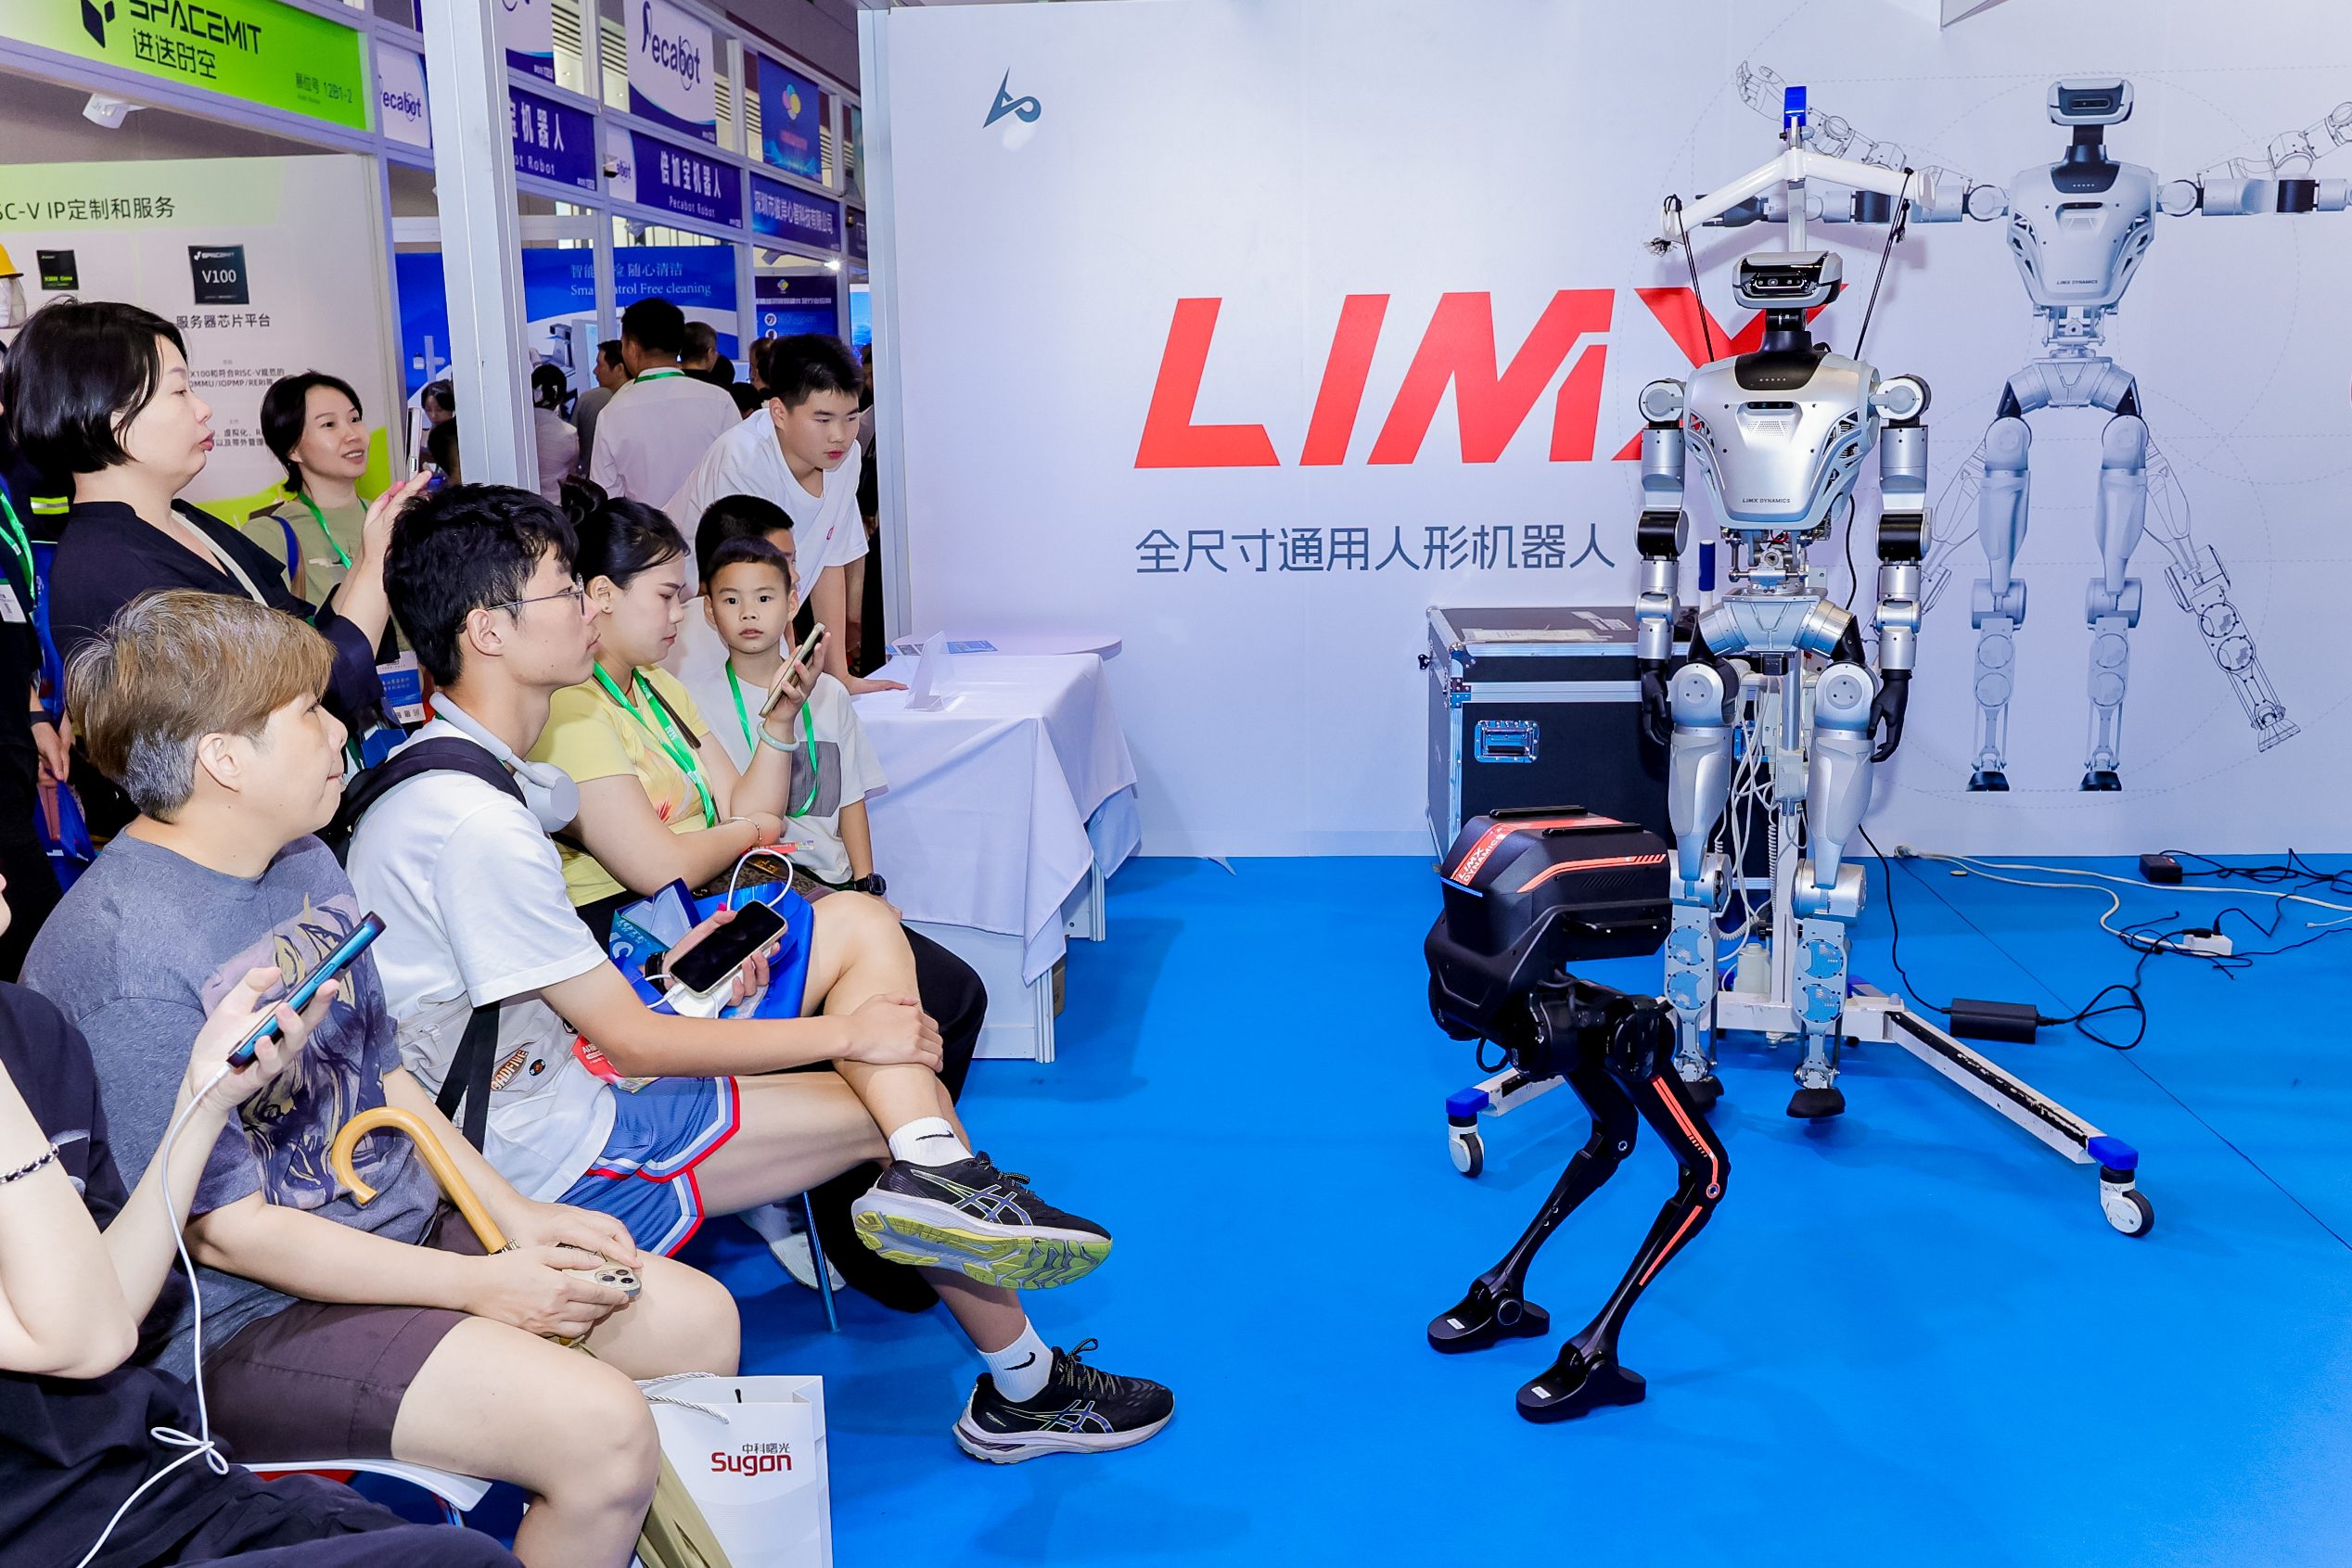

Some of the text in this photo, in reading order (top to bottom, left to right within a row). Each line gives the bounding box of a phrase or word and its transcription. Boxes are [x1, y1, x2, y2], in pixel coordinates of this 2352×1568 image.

[129, 0, 262, 55] SPACEMIT
[378, 74, 422, 121] ecabot
[510, 102, 564, 152] 机器人
[527, 155, 556, 175] Robot
[47, 196, 176, 221] IP定制和服务
[669, 195, 716, 218] Pecabot Robot
[201, 269, 237, 284] V100
[571, 281, 711, 297] Sma trol Free cleaning
[176, 312, 272, 329] 服务器芯片平台
[1134, 522, 1617, 574] 全尺寸通用人形机器人
[1458, 847, 1484, 880] LIMX
[742, 1442, 791, 1455] 中科曙光
[711, 1452, 792, 1477] Sugon
